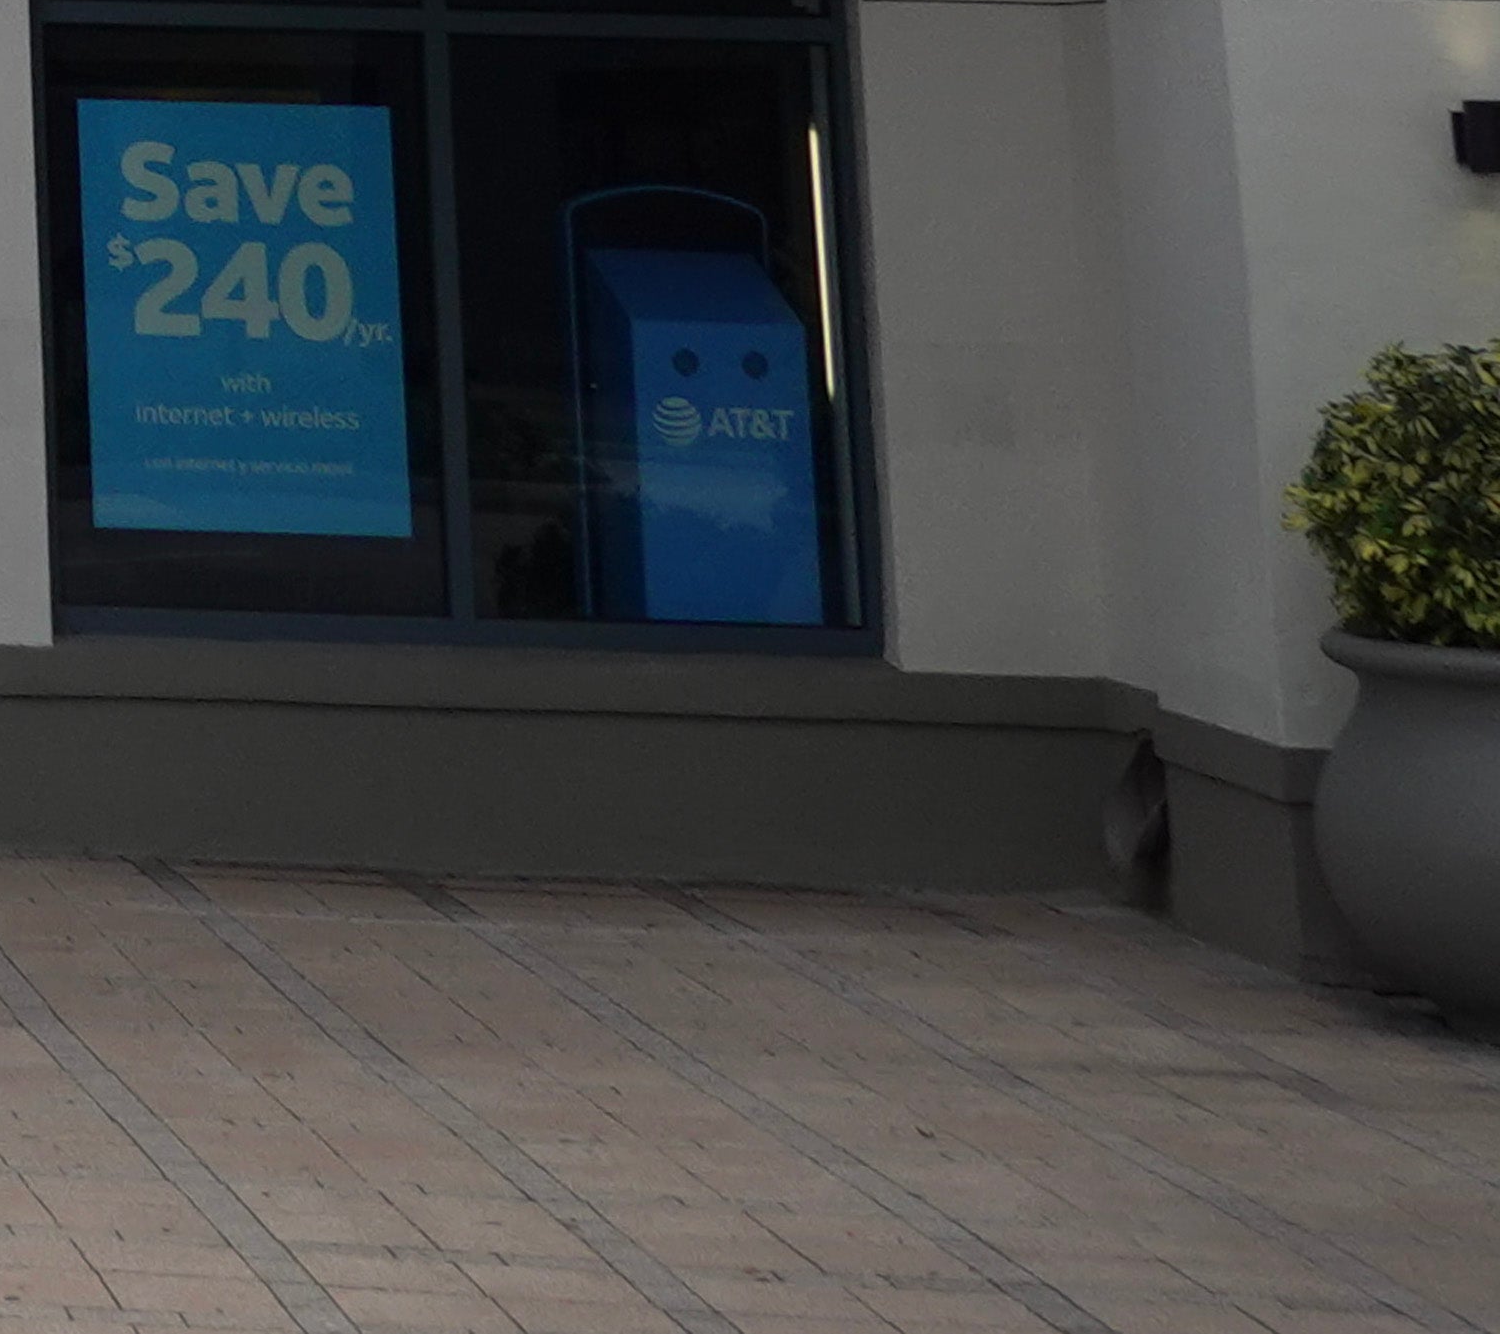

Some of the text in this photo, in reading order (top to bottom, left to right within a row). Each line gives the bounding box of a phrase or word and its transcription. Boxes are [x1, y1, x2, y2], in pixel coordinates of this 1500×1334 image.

[120, 140, 354, 227] Save
[220, 370, 272, 395] with
[135, 401, 235, 427] internet
[261, 404, 360, 432] wireless
[707, 407, 795, 440] AT&T
